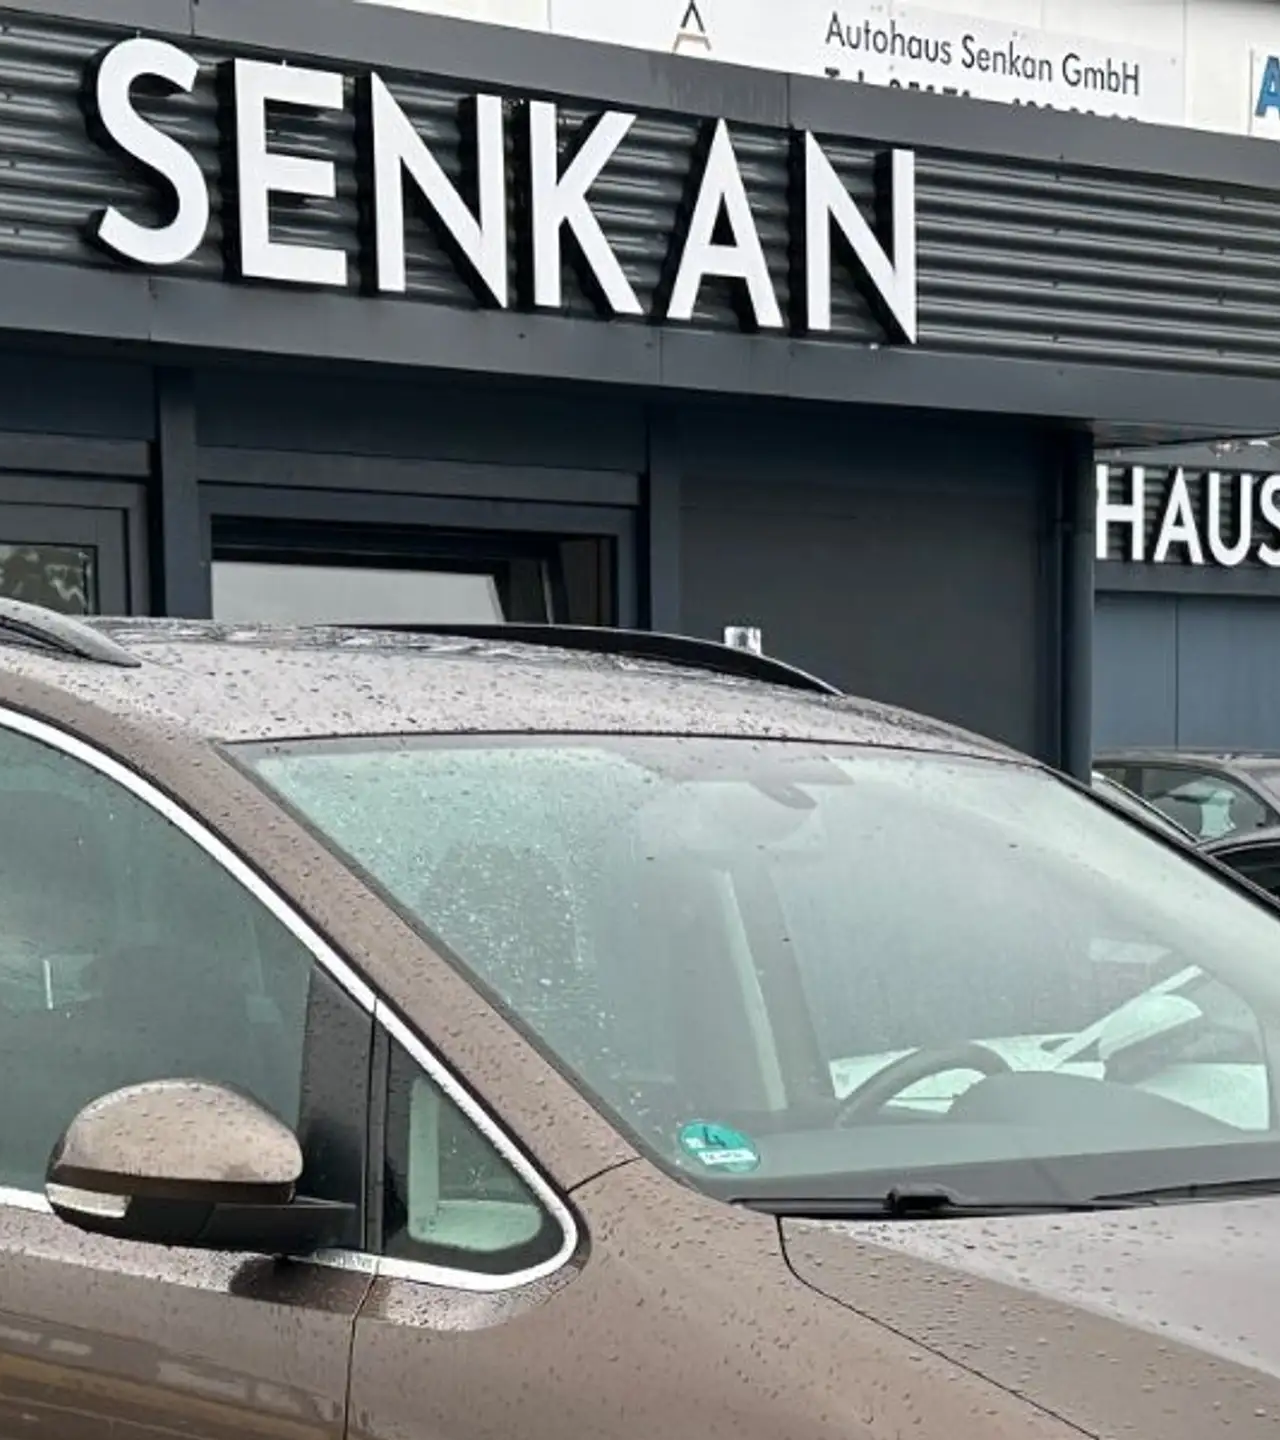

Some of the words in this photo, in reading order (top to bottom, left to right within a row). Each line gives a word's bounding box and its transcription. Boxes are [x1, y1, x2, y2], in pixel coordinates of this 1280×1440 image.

[825, 13, 952, 66] Autohaus
[961, 36, 1053, 82] Senkan
[1062, 52, 1141, 97] GmbH
[96, 40, 917, 345] SENKAN
